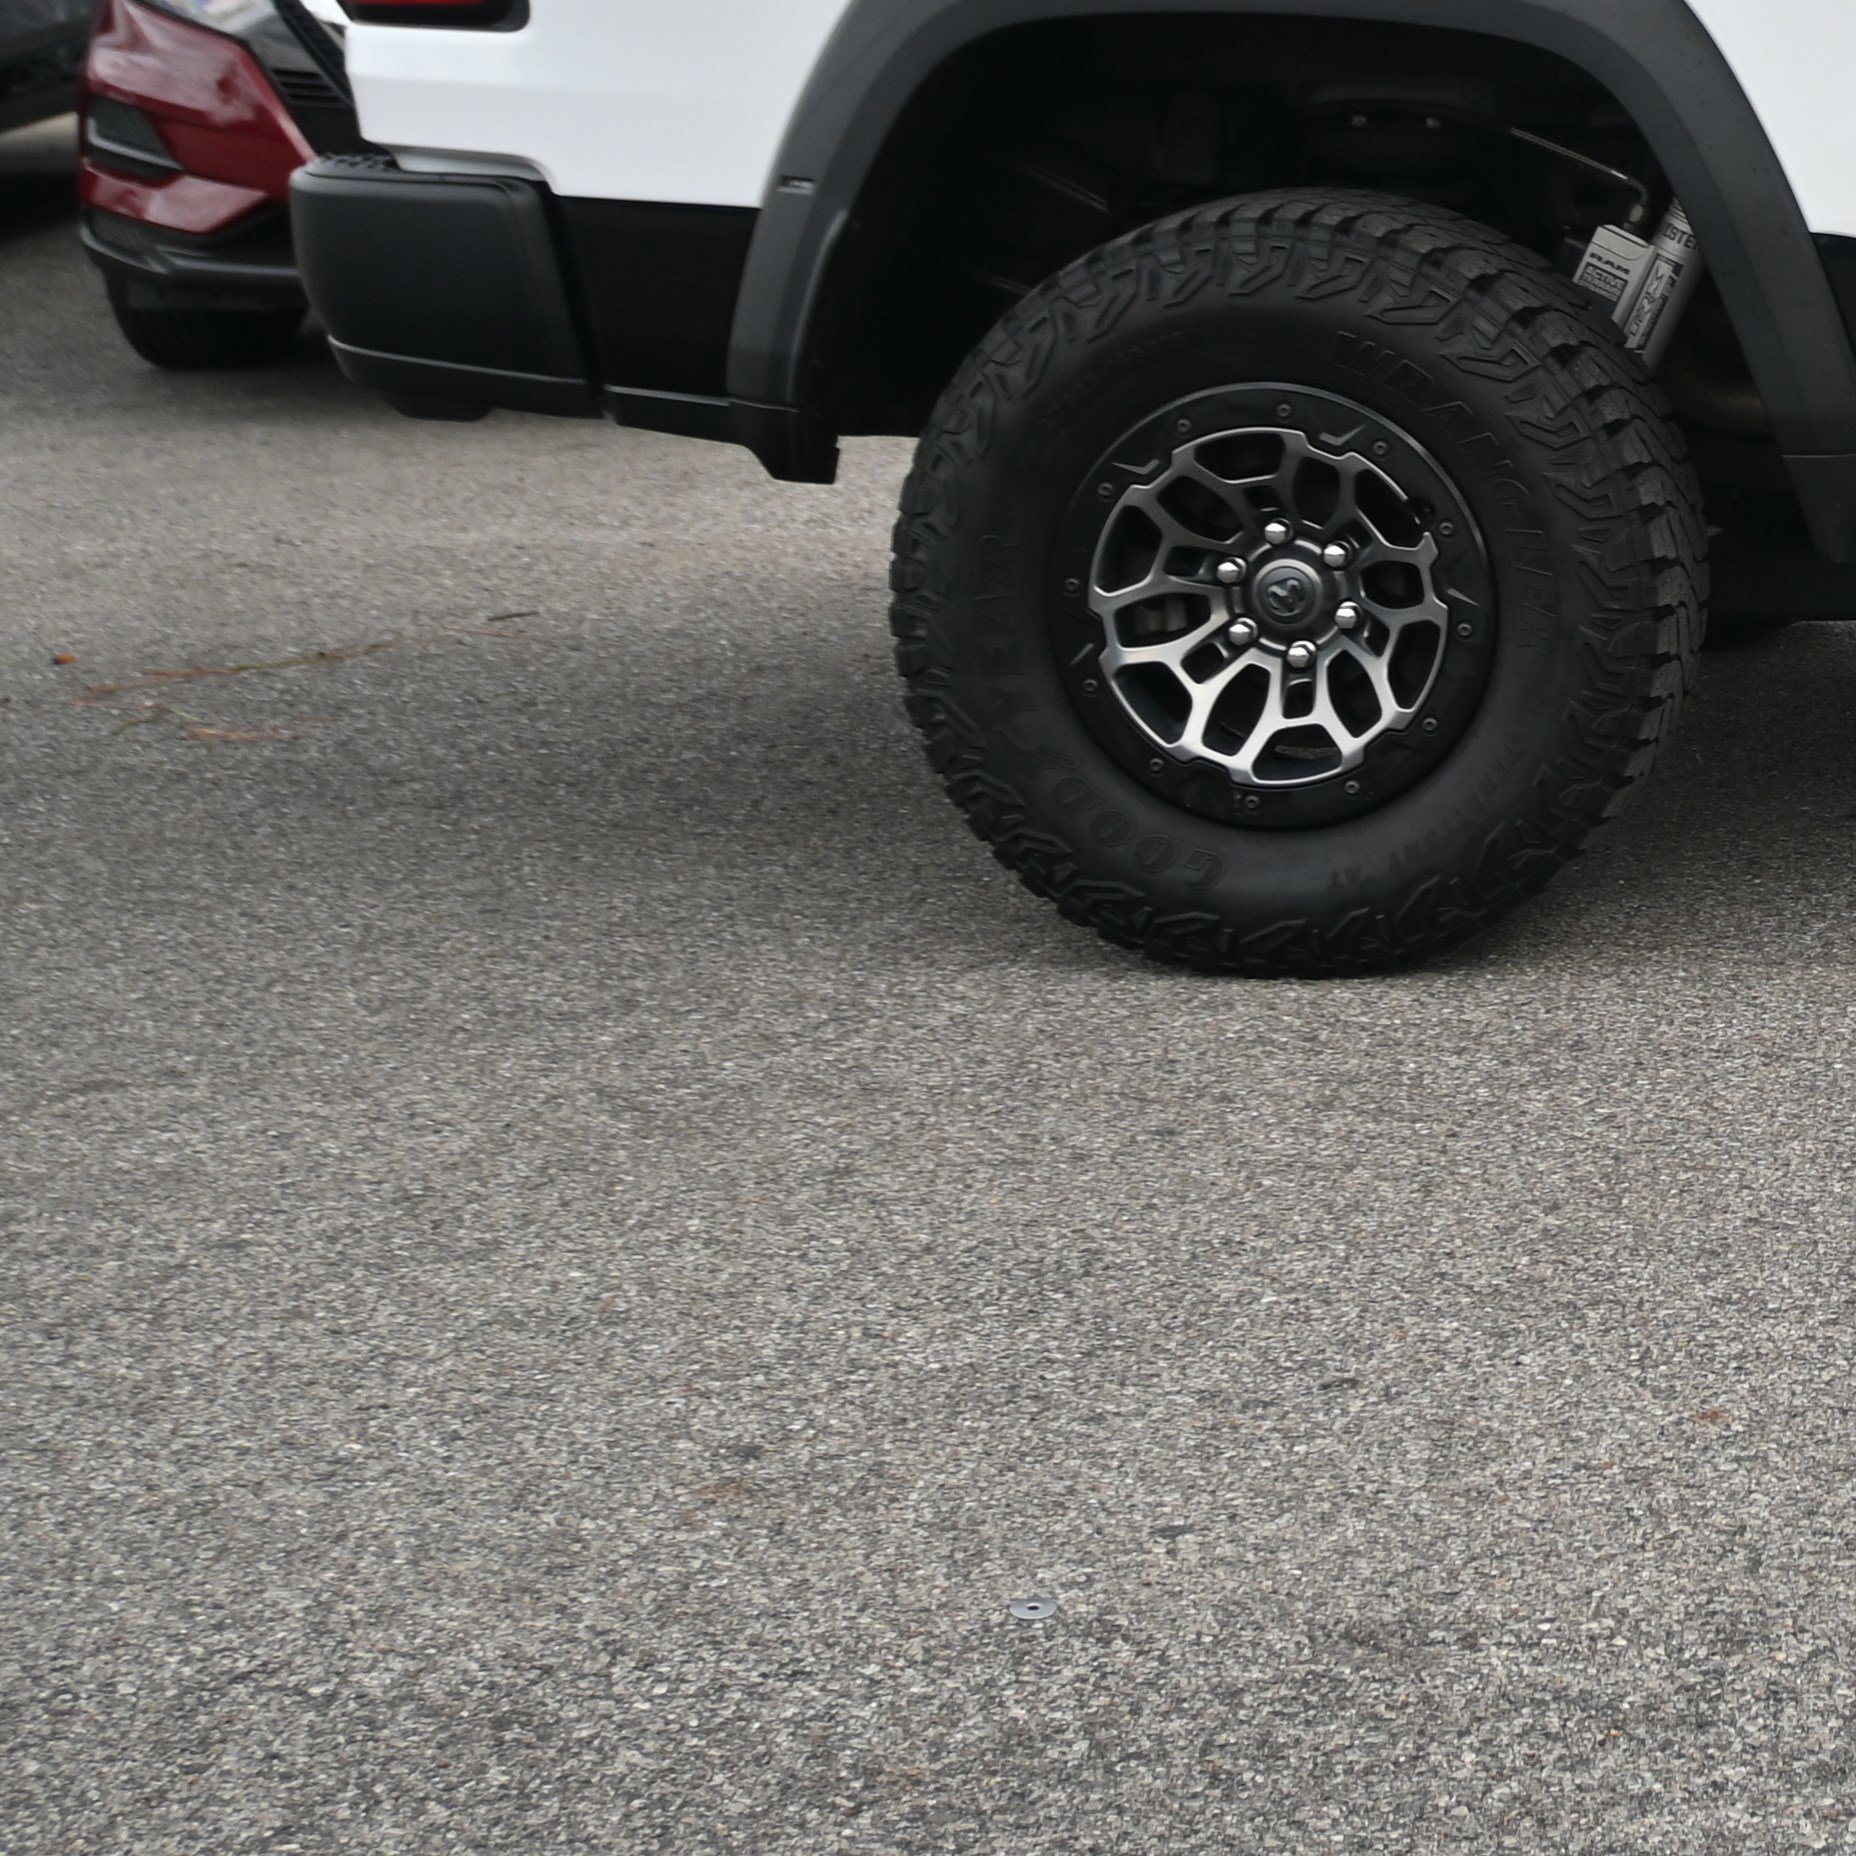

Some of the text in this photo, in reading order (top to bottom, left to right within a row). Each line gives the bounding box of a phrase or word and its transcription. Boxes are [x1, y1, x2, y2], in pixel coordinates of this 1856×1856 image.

[1589, 251, 1630, 275] RAM
[1329, 330, 1552, 654] WRANGLER
[971, 534, 1225, 892] GOODYEAR
